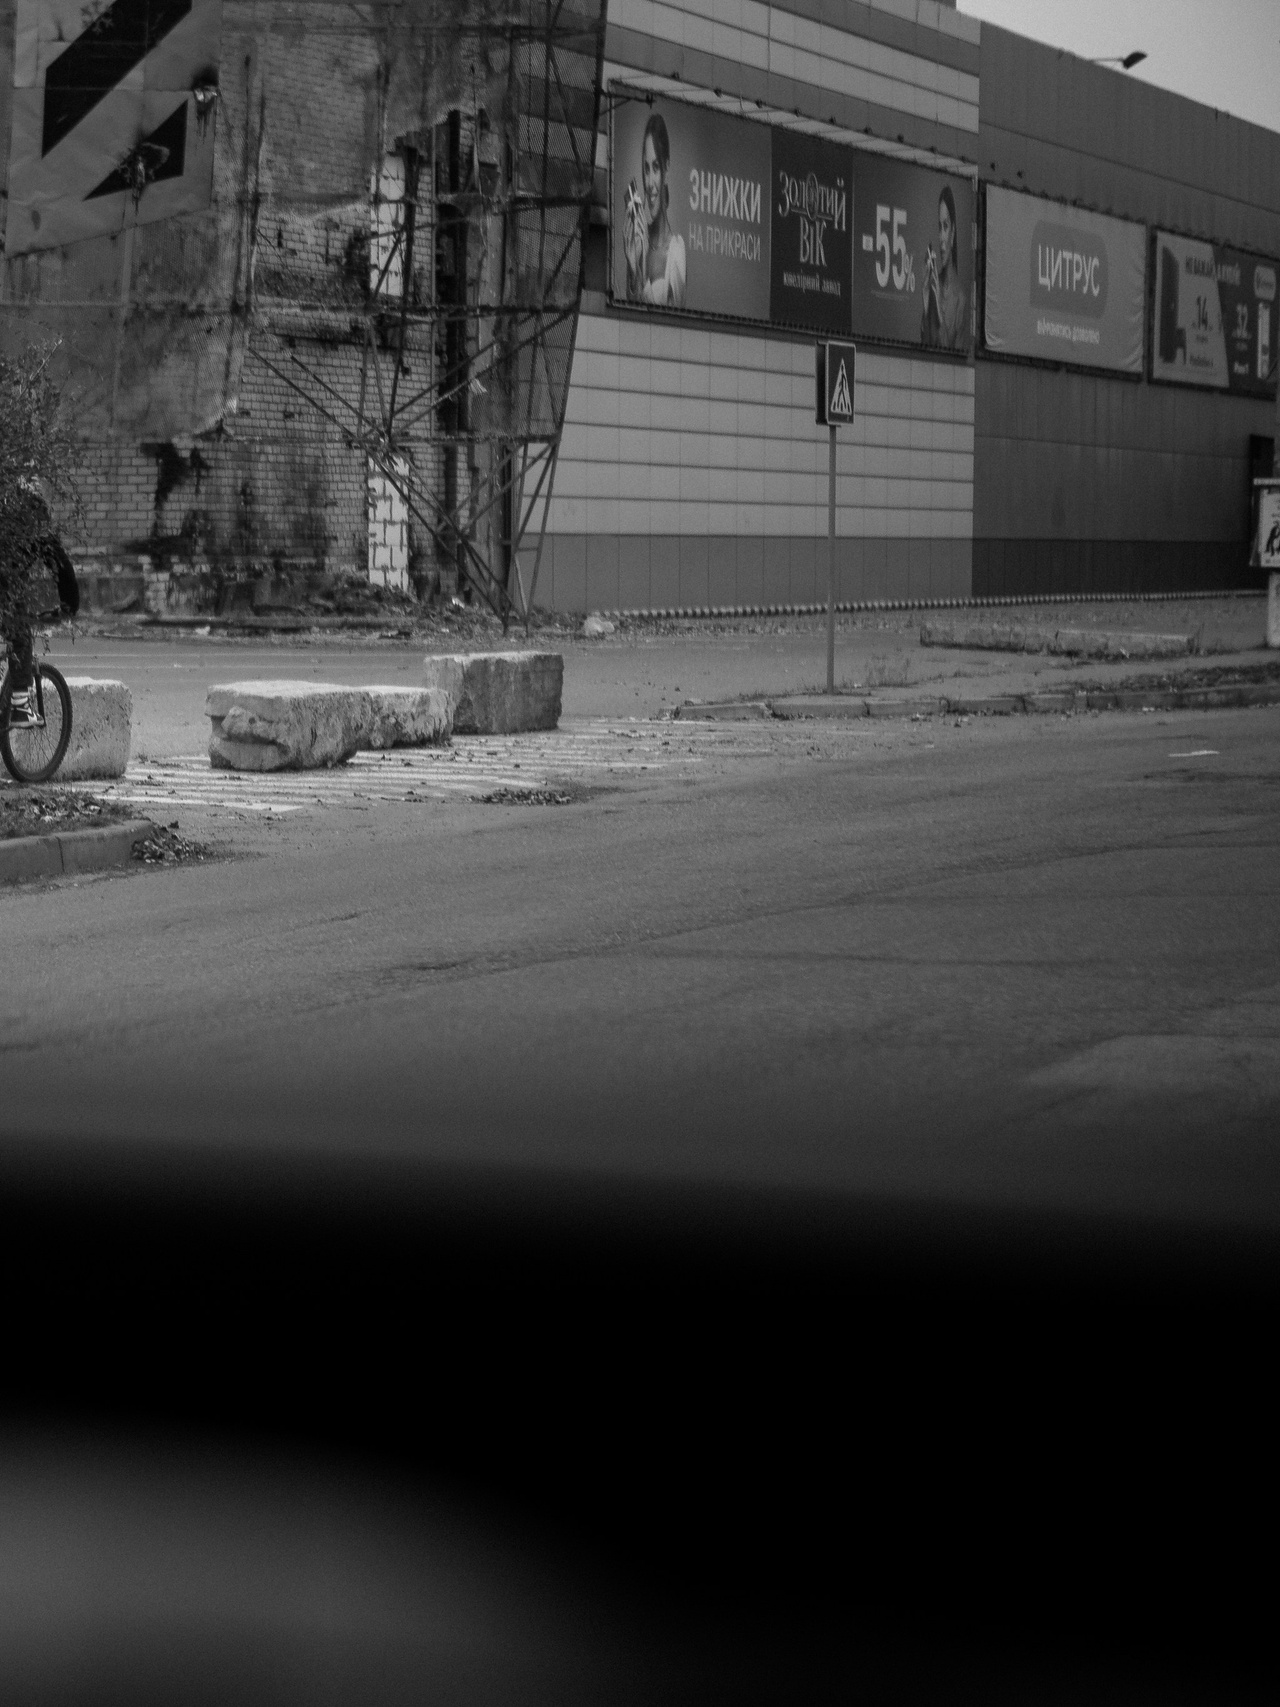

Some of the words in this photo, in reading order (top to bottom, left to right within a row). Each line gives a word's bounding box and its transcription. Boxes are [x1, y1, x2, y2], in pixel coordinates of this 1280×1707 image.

[689, 169, 761, 224] ЗНИЖКИ
[689, 225, 705, 252] НА
[706, 228, 761, 263] ПРИКРАСИ
[862, 204, 916, 293] -55%
[1038, 244, 1100, 297] ЦИТРУС
[1196, 296, 1209, 331] 14
